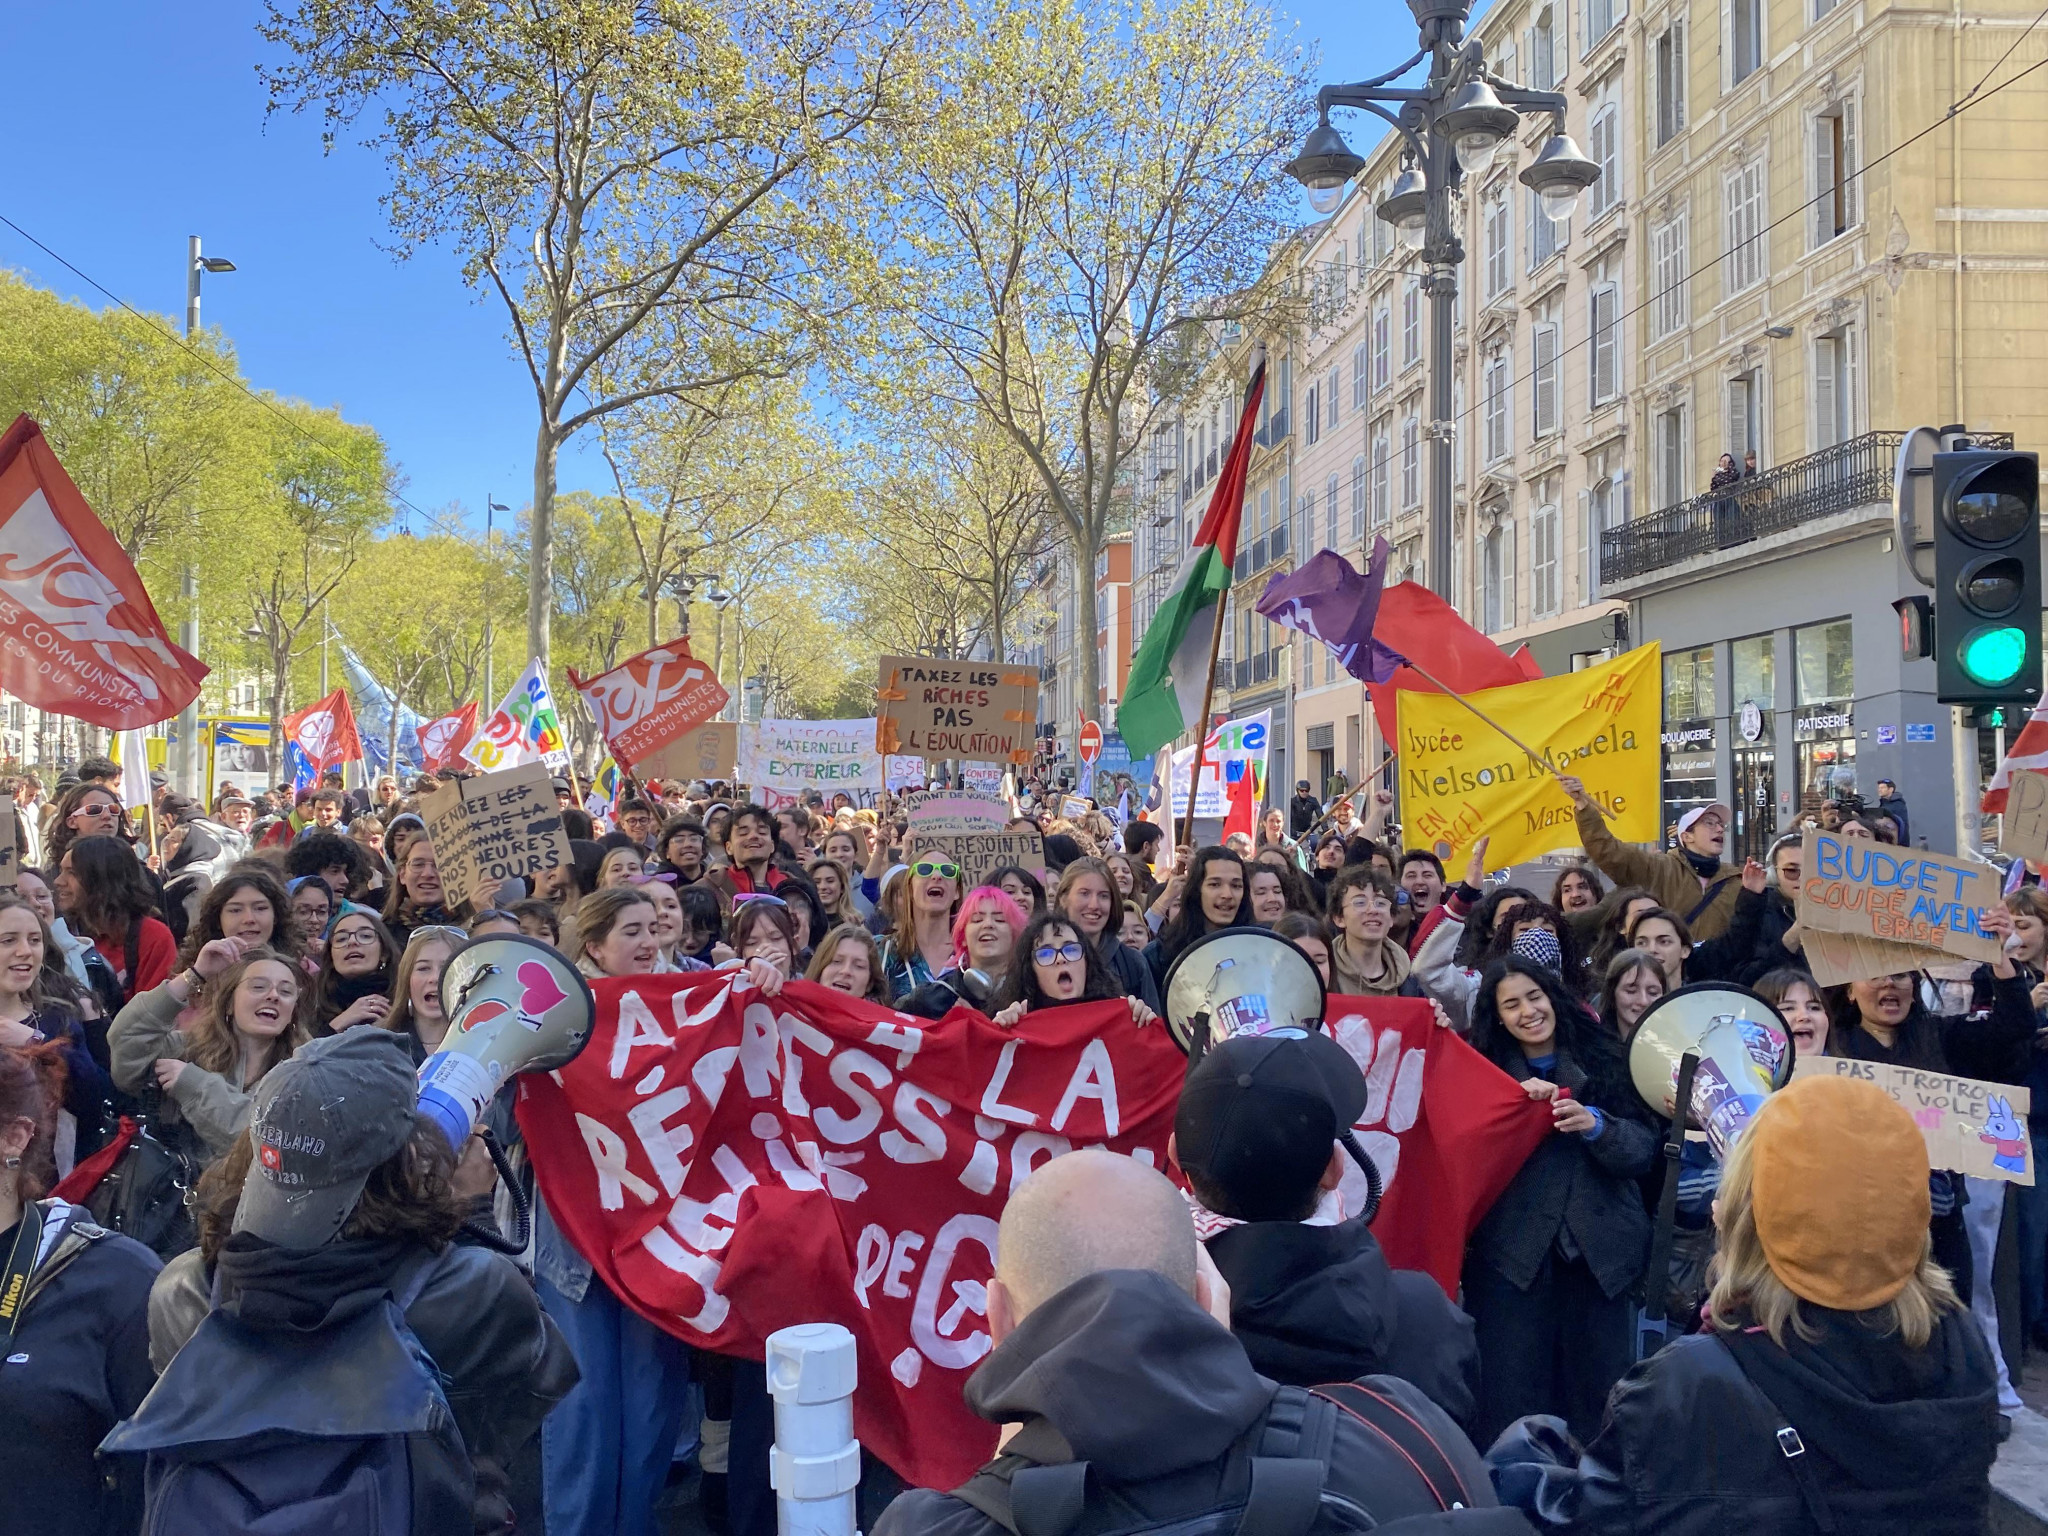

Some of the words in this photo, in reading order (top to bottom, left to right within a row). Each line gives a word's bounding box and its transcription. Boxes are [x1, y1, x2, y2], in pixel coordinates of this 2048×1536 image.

[22, 622, 146, 706] COMMUNISTES
[902, 667, 962, 683] TAXEZ
[969, 672, 998, 687] LES
[633, 680, 716, 737] COMMUNISTES
[933, 707, 974, 727] PAS
[1798, 714, 1850, 731] PATISSERIE
[776, 738, 859, 754] MATERNELLE
[1408, 727, 1464, 759] lycée
[1661, 728, 1711, 744] BOULANGERIE
[965, 768, 999, 780] CONTRE
[1409, 762, 1516, 798] Nelson
[429, 797, 490, 842] RENDEZ
[497, 785, 532, 806] LES
[907, 791, 946, 805] AVANT
[949, 791, 962, 799] DE
[490, 810, 512, 828] DE
[1416, 806, 1448, 838] EN
[1432, 801, 1487, 862] ORCE!
[442, 859, 468, 887] NOS
[473, 833, 555, 867] HEURES
[915, 836, 948, 852] PAS
[1020, 835, 1042, 854] DE
[1817, 836, 1978, 900] BUDGET
[447, 881, 468, 906] DE
[1805, 877, 1907, 917] COUPÉ
[1909, 895, 1997, 939] AVEN
[980, 1038, 1120, 1138] LA
[1836, 1060, 1876, 1081] PAS
[1894, 1068, 1988, 1100] TROTRO
[1916, 1092, 1984, 1120] VOLE
[0, 1273, 24, 1318] Nikon
